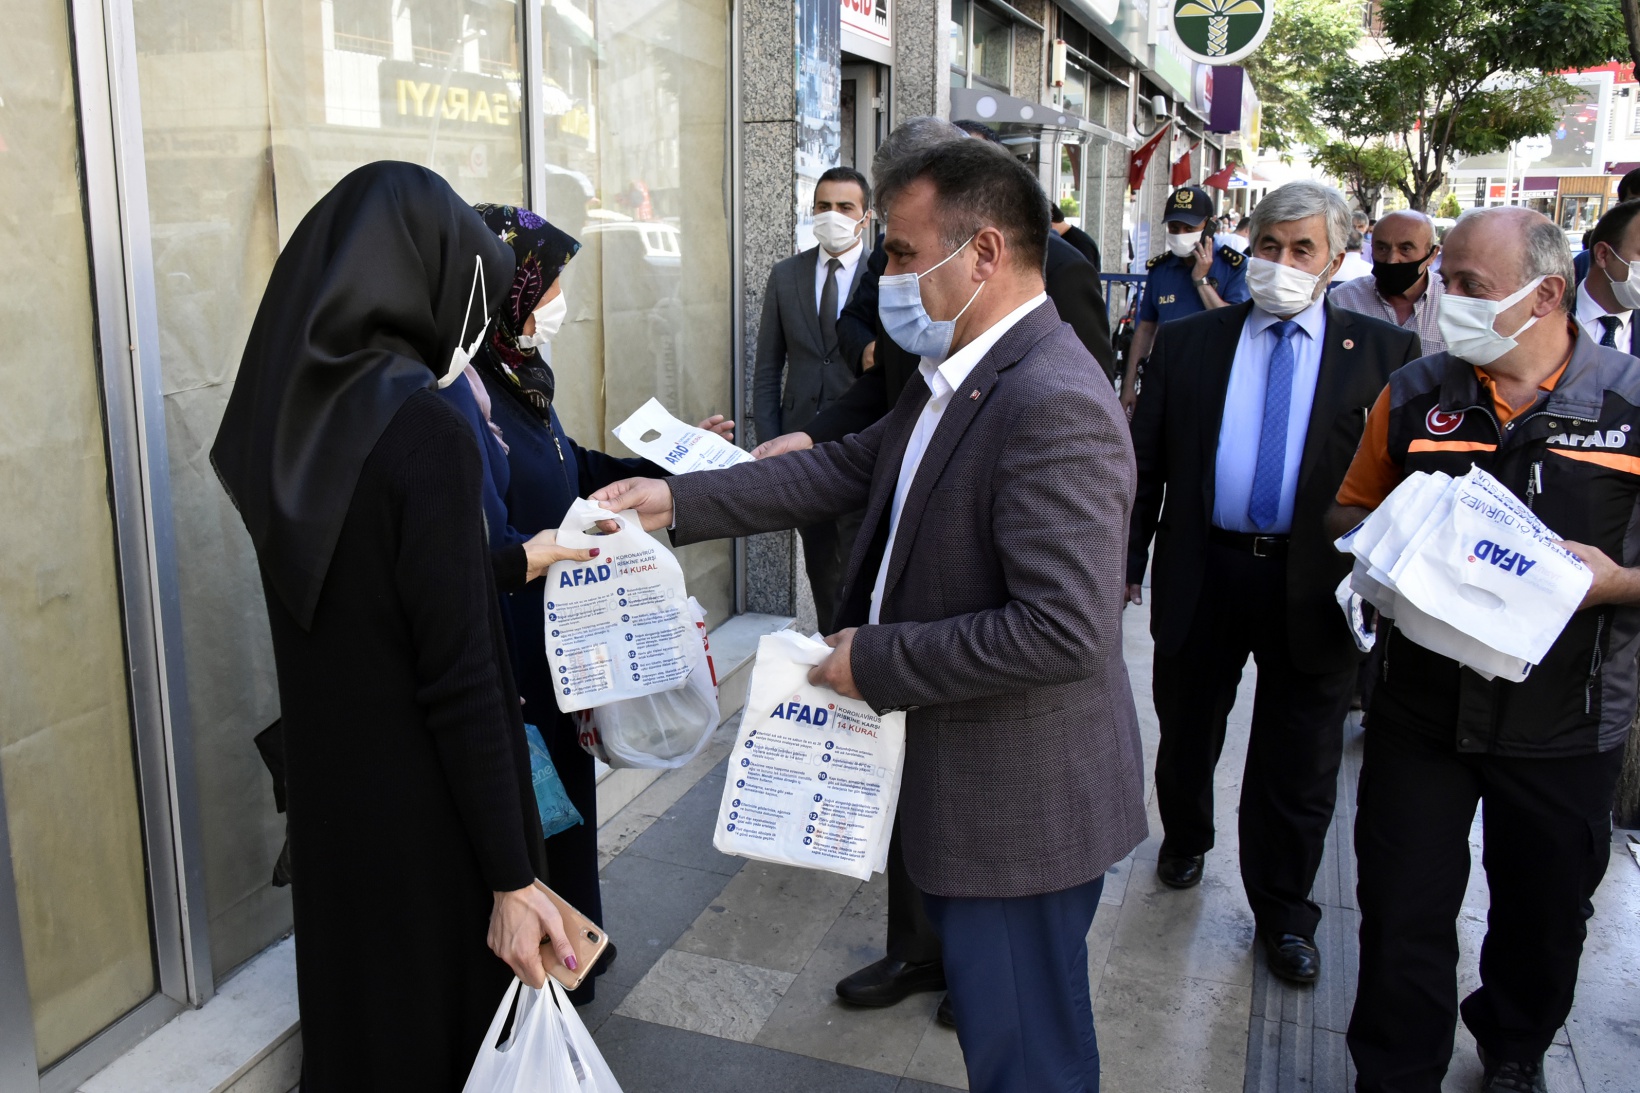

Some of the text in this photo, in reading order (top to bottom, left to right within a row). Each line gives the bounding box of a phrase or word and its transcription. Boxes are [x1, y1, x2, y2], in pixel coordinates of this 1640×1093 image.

[1546, 430, 1626, 448] AFAD
[665, 445, 689, 465] AFAD
[1474, 539, 1537, 577] AFAD
[559, 564, 611, 588] AFAD
[630, 563, 658, 574] KURAL
[769, 702, 828, 726] AFAD
[838, 707, 882, 724] KORONAVİRÜS
[837, 721, 878, 739] 14 KURAL
